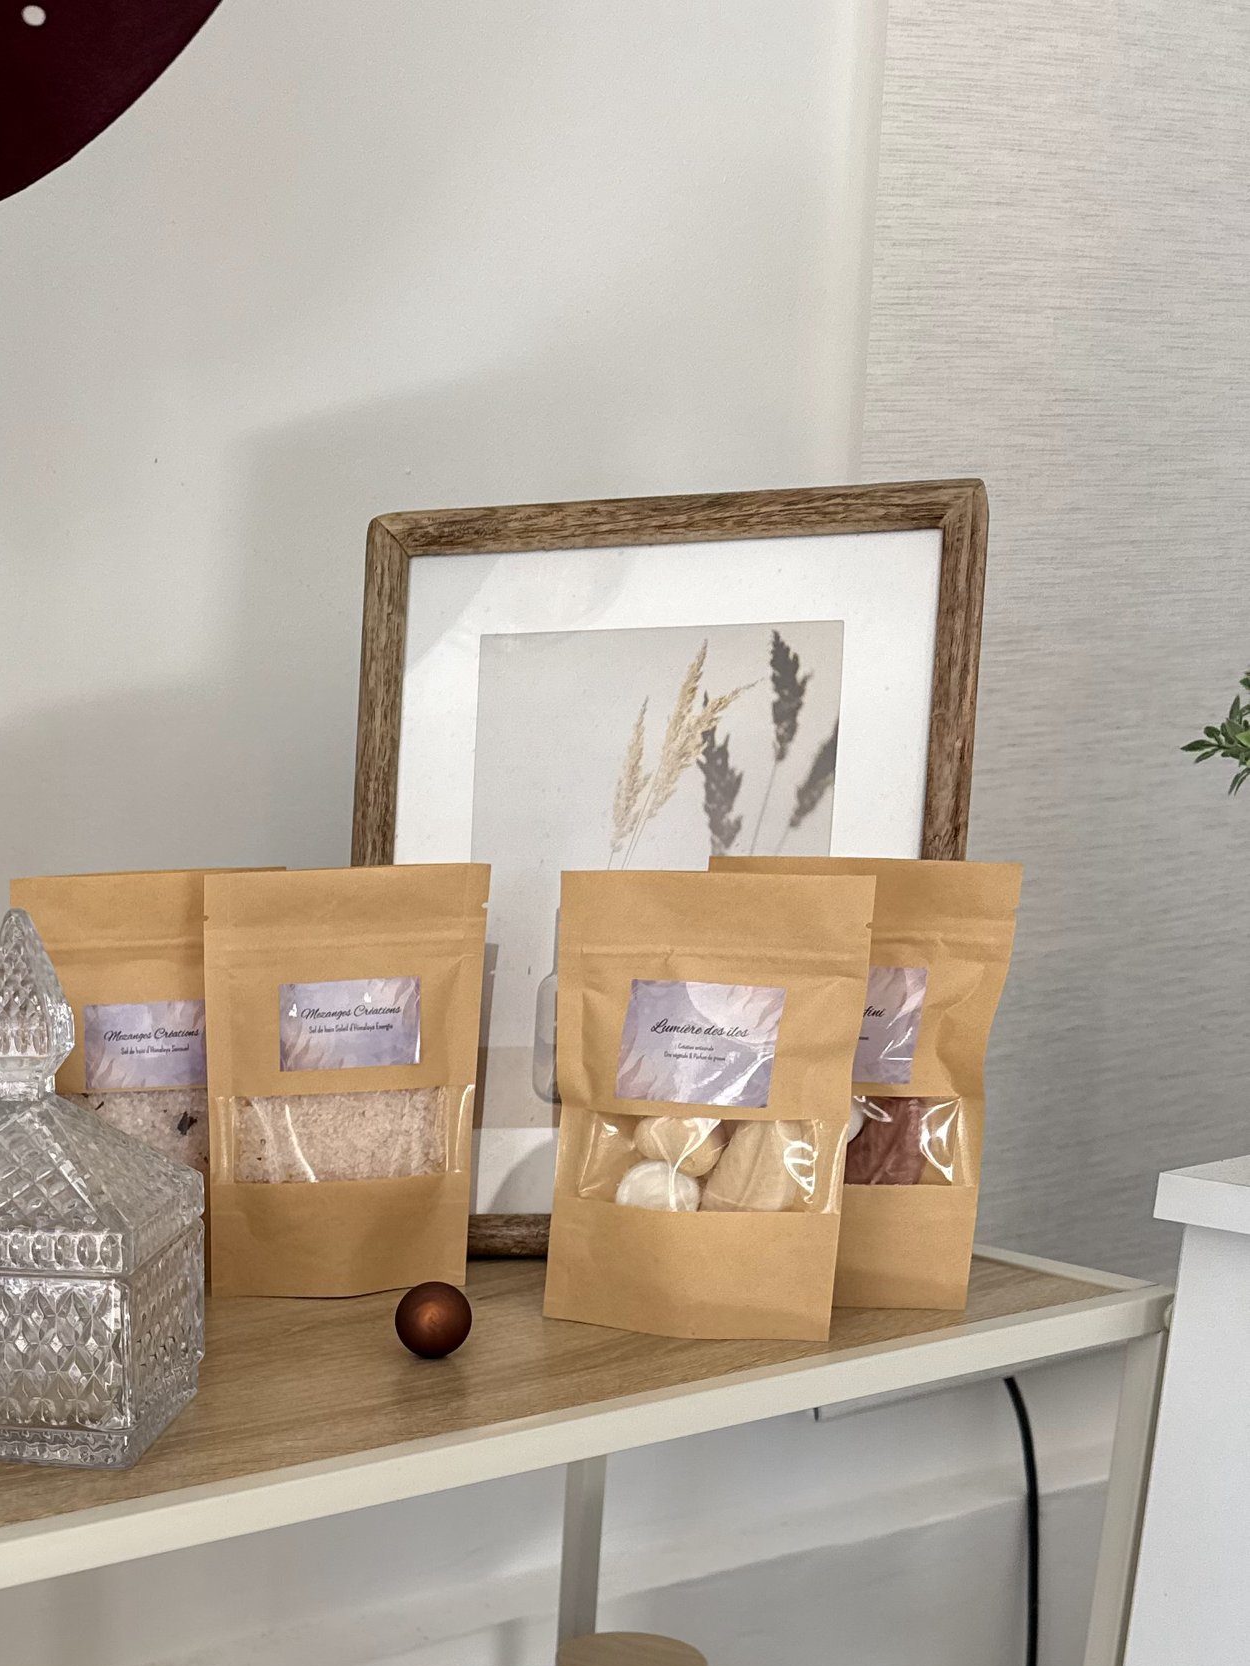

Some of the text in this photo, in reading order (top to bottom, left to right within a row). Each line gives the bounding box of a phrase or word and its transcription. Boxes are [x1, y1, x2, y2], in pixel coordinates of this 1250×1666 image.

[301, 1004, 401, 1021] Mezanges Créations
[862, 1005, 886, 1018] fini
[650, 1018, 702, 1034] Lumière
[704, 1025, 724, 1036] des
[103, 1030, 152, 1042] Mezanges
